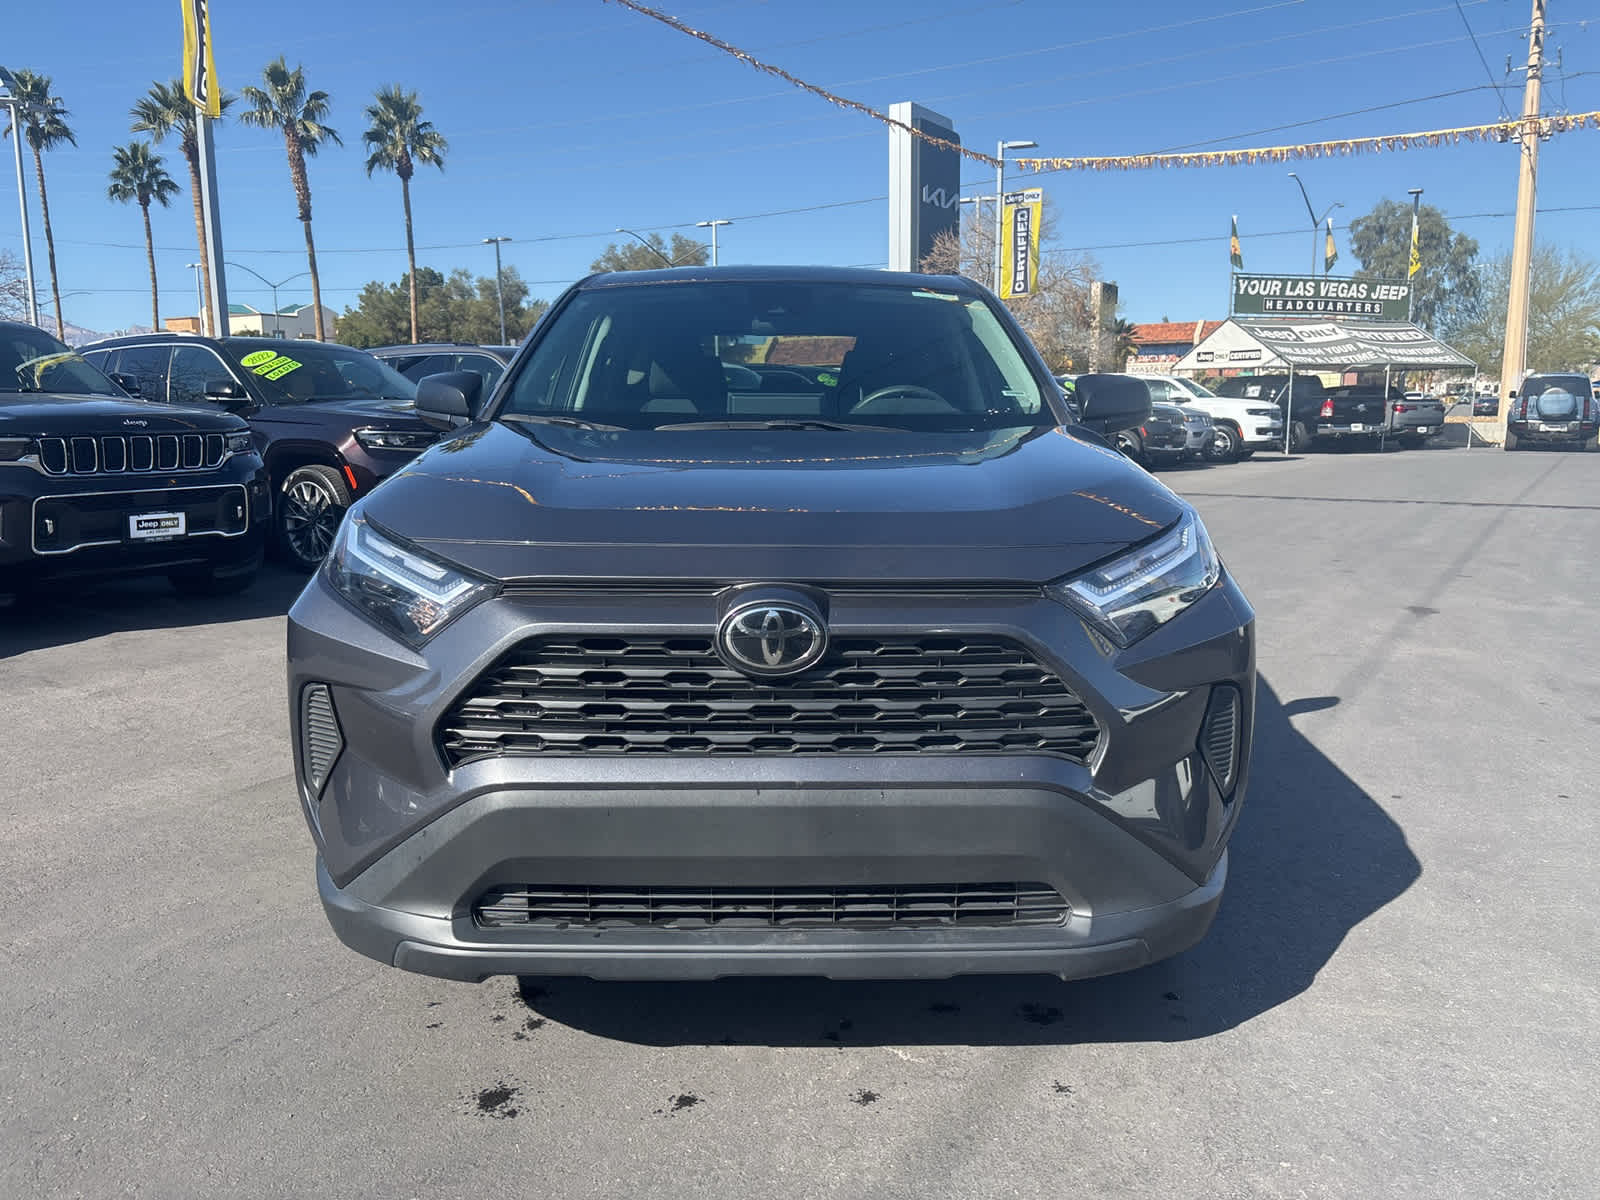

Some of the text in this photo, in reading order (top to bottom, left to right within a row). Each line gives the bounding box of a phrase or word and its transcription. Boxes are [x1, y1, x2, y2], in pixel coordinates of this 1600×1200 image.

[1006, 194, 1024, 204] Jeep
[1015, 209, 1028, 292] CERTIFIED
[1239, 279, 1408, 301] YOUR LAS VEGAS JEEP
[1265, 300, 1381, 313] HEADQUARTERS
[1253, 327, 1425, 341] Jeep ONLY RTIFIED
[1324, 343, 1357, 354] YOUR
[1198, 353, 1213, 361] Jeep
[138, 519, 178, 529] Jeep ONLY
